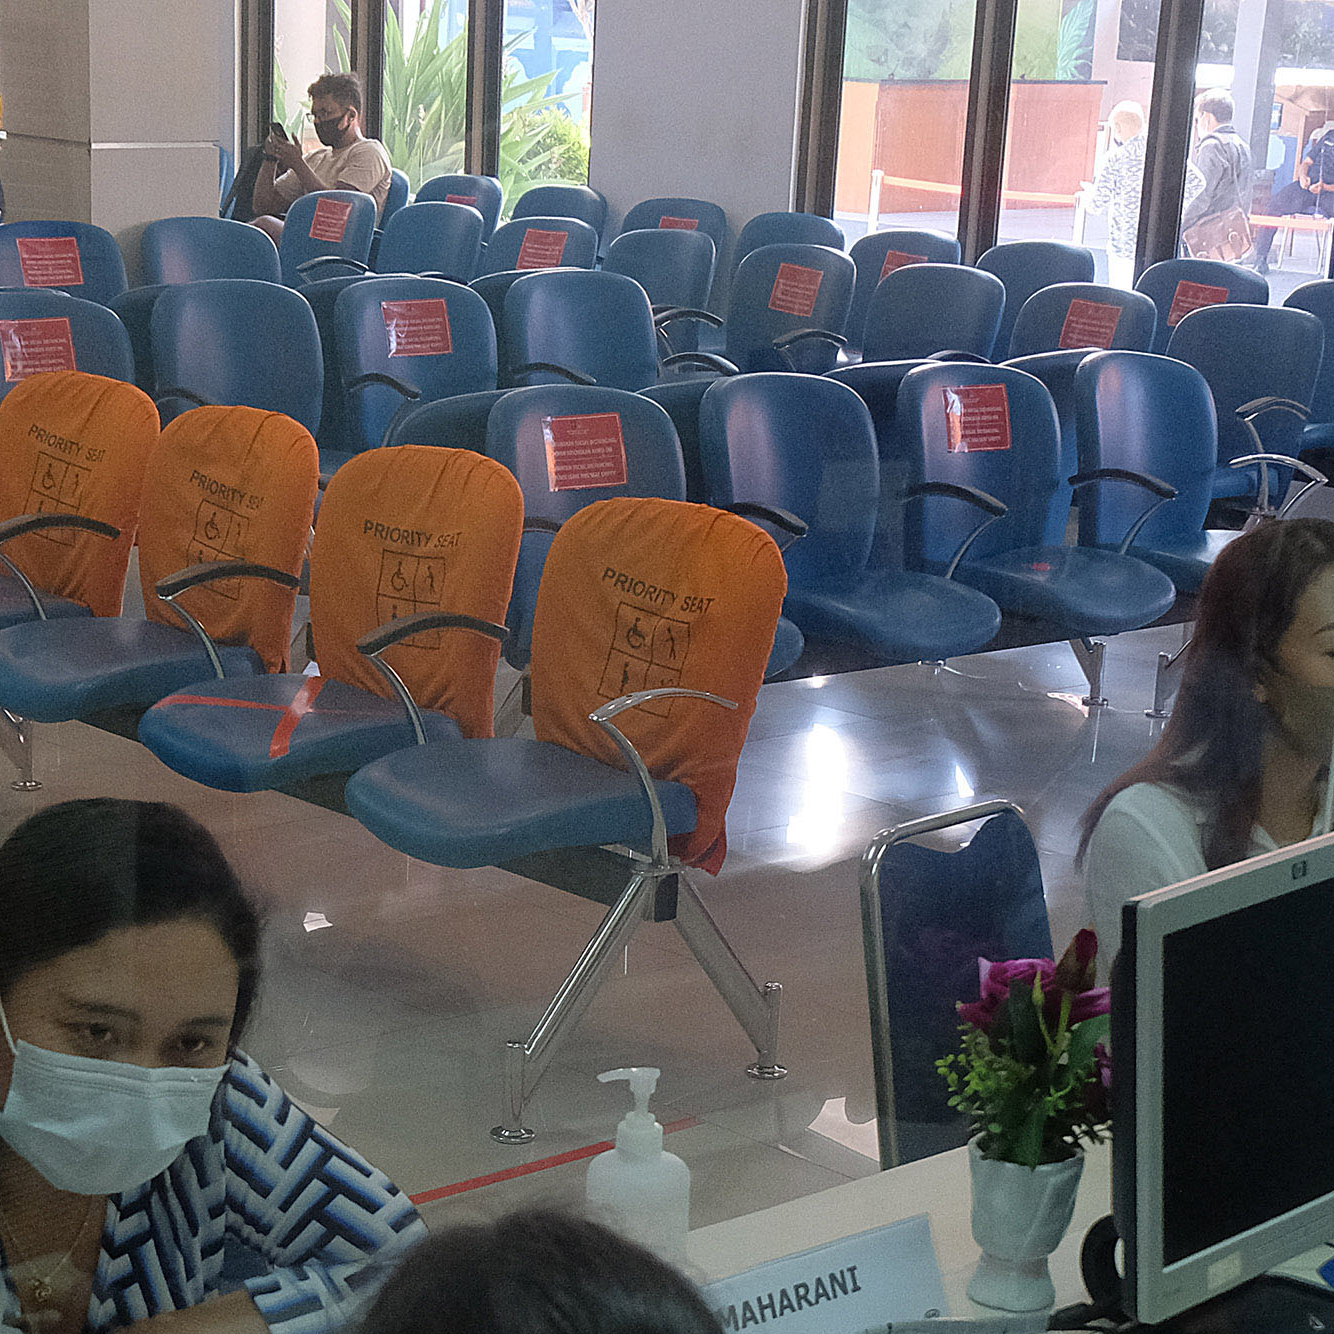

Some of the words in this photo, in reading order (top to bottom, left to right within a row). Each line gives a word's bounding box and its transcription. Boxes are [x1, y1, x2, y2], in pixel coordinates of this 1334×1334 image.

[28, 424, 83, 456] PRIORITY
[189, 469, 247, 506] PRIORITY
[363, 520, 434, 548] PRIORITY
[434, 532, 463, 548] SEAT
[602, 567, 678, 608] PRIORITY
[680, 596, 716, 615] SEAT
[717, 1265, 862, 1332] MAHARANI
